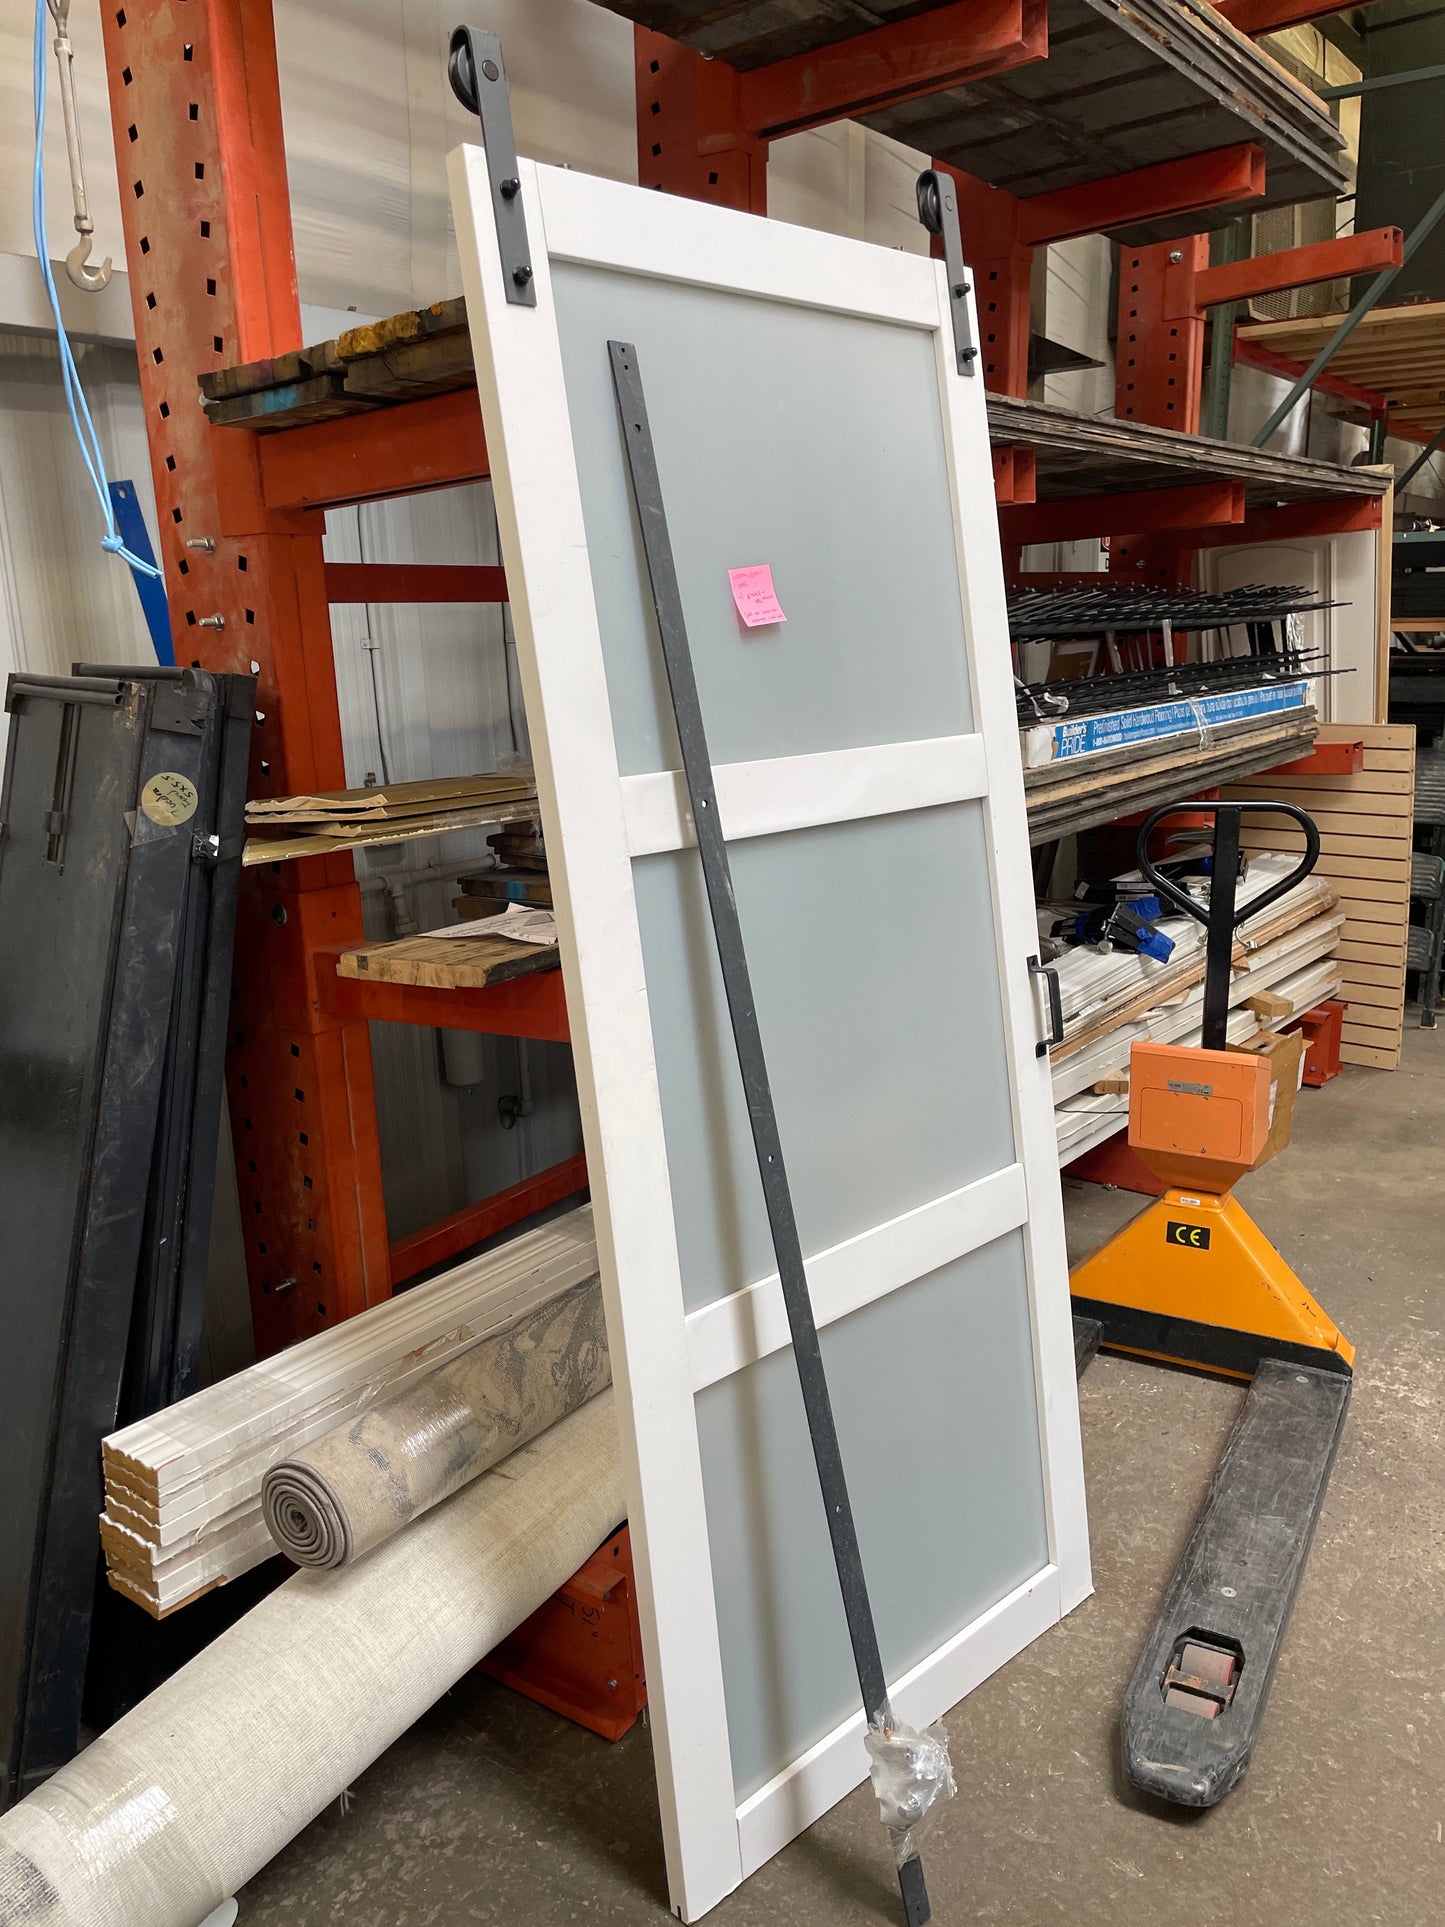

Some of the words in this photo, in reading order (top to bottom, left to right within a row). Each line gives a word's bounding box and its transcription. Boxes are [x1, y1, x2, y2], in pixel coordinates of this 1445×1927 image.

[1062, 722, 1087, 738] Builder's
[1093, 719, 1120, 736] Prefinished
[1120, 715, 1132, 730] Solid
[1132, 711, 1155, 727] Hardwood
[1154, 708, 1173, 723] Flooring
[1060, 734, 1087, 757] PRIDE
[1175, 1225, 1202, 1247] CE
